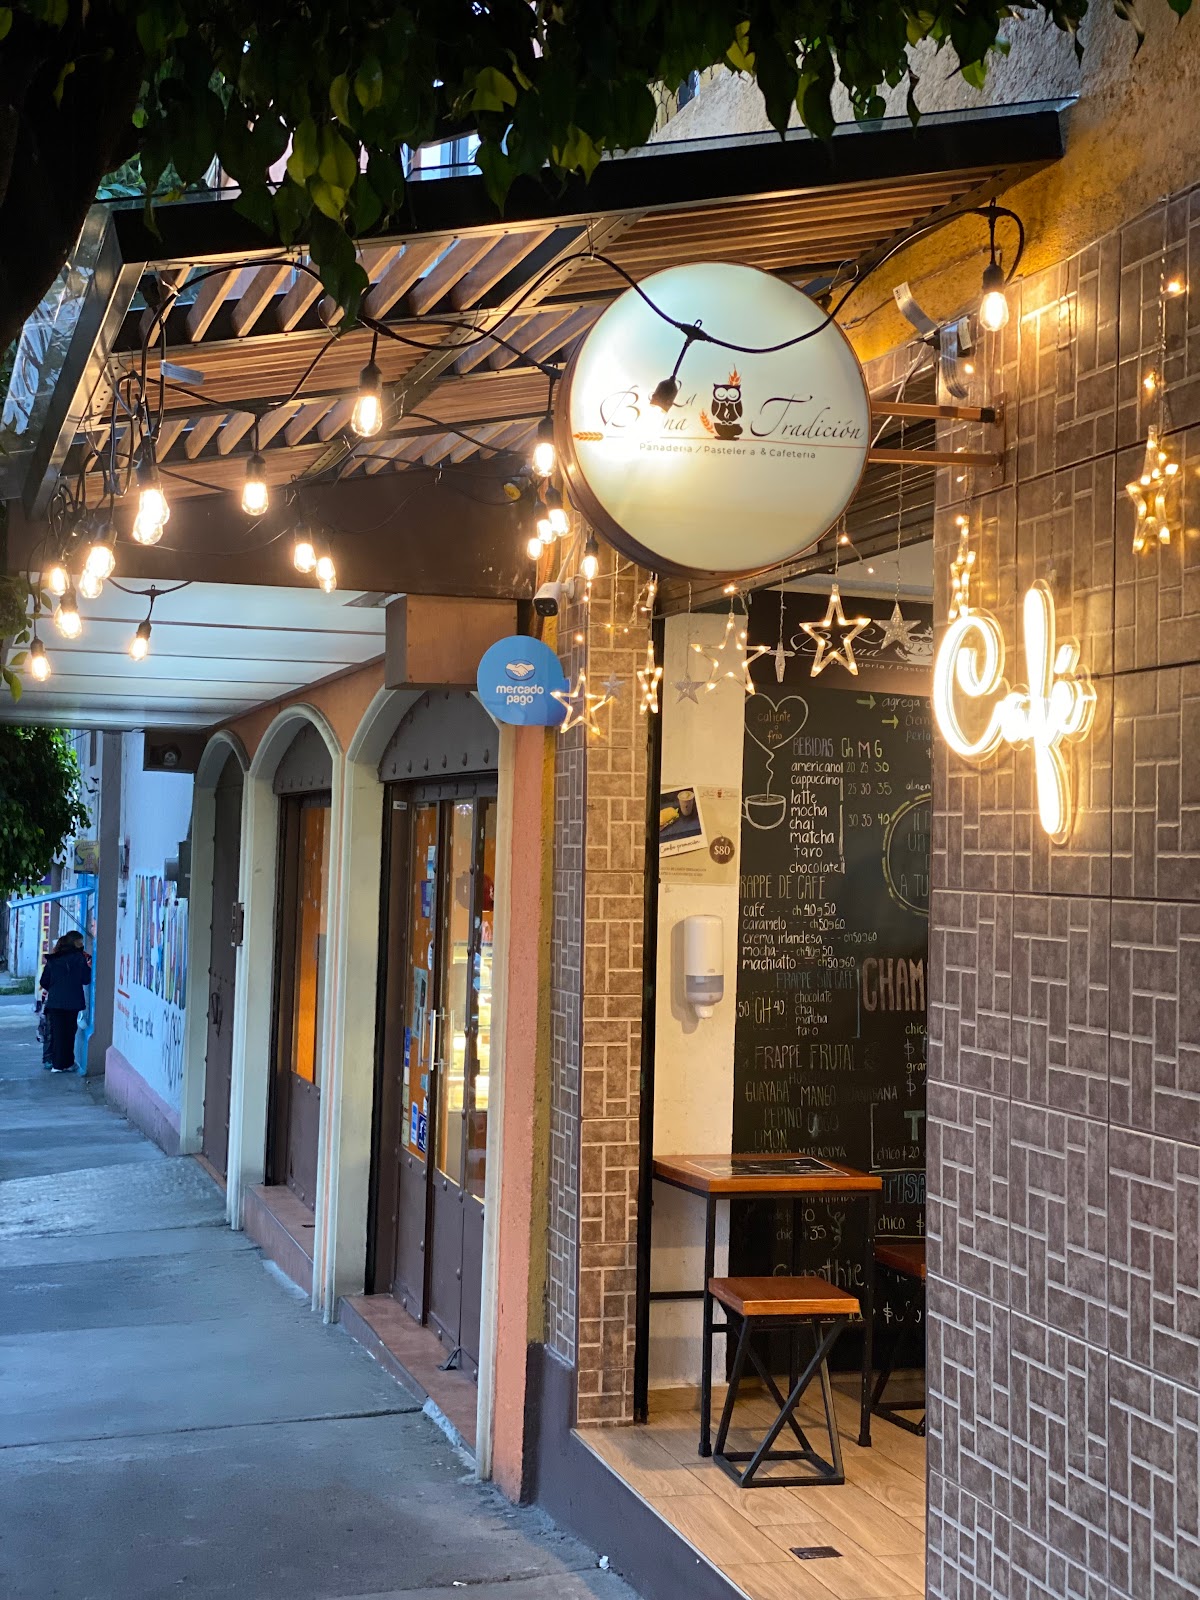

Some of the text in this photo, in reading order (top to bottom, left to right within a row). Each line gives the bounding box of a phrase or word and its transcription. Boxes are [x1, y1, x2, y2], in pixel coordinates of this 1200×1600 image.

[600, 384, 864, 440] Bna Tradición
[705, 445, 756, 456] Pastelera
[762, 447, 767, 456] &
[790, 628, 884, 658] Buna
[496, 684, 544, 694] mercado
[506, 695, 534, 706] pago
[881, 697, 921, 713] agrega
[757, 709, 791, 722] caliente
[792, 737, 834, 758] BEBIDAS
[858, 741, 871, 759] M
[874, 739, 883, 758] G
[791, 761, 890, 774] americano 20 25 30
[790, 774, 840, 789] cappuccino
[860, 783, 872, 795] 30
[877, 782, 893, 796] 35
[791, 789, 818, 805] latte
[790, 805, 828, 817] mocha
[789, 817, 815, 831] chai
[861, 814, 873, 827] 35
[878, 813, 890, 826] 40
[790, 830, 835, 844] matcha
[714, 845, 731, 856] $80
[794, 844, 824, 858] taro
[789, 862, 840, 875] chocolate
[779, 874, 792, 899] DE
[900, 873, 908, 897] A
[743, 902, 765, 917] café
[742, 916, 787, 931] caramelo
[742, 933, 774, 945] crema
[778, 930, 823, 945] irlandesa
[742, 945, 776, 957] mocha
[862, 957, 926, 1012] CHAM
[794, 990, 833, 1003] chocolate
[738, 1000, 750, 1017] 50
[754, 995, 772, 1024] CH
[795, 1014, 829, 1025] matcha
[795, 1025, 819, 1036] taro
[810, 1043, 856, 1071] FRUTAL
[744, 1079, 791, 1103] GUAYABA
[800, 1084, 837, 1107] MANGO
[764, 1106, 803, 1129] PEPINO
[877, 1214, 906, 1231] chico
